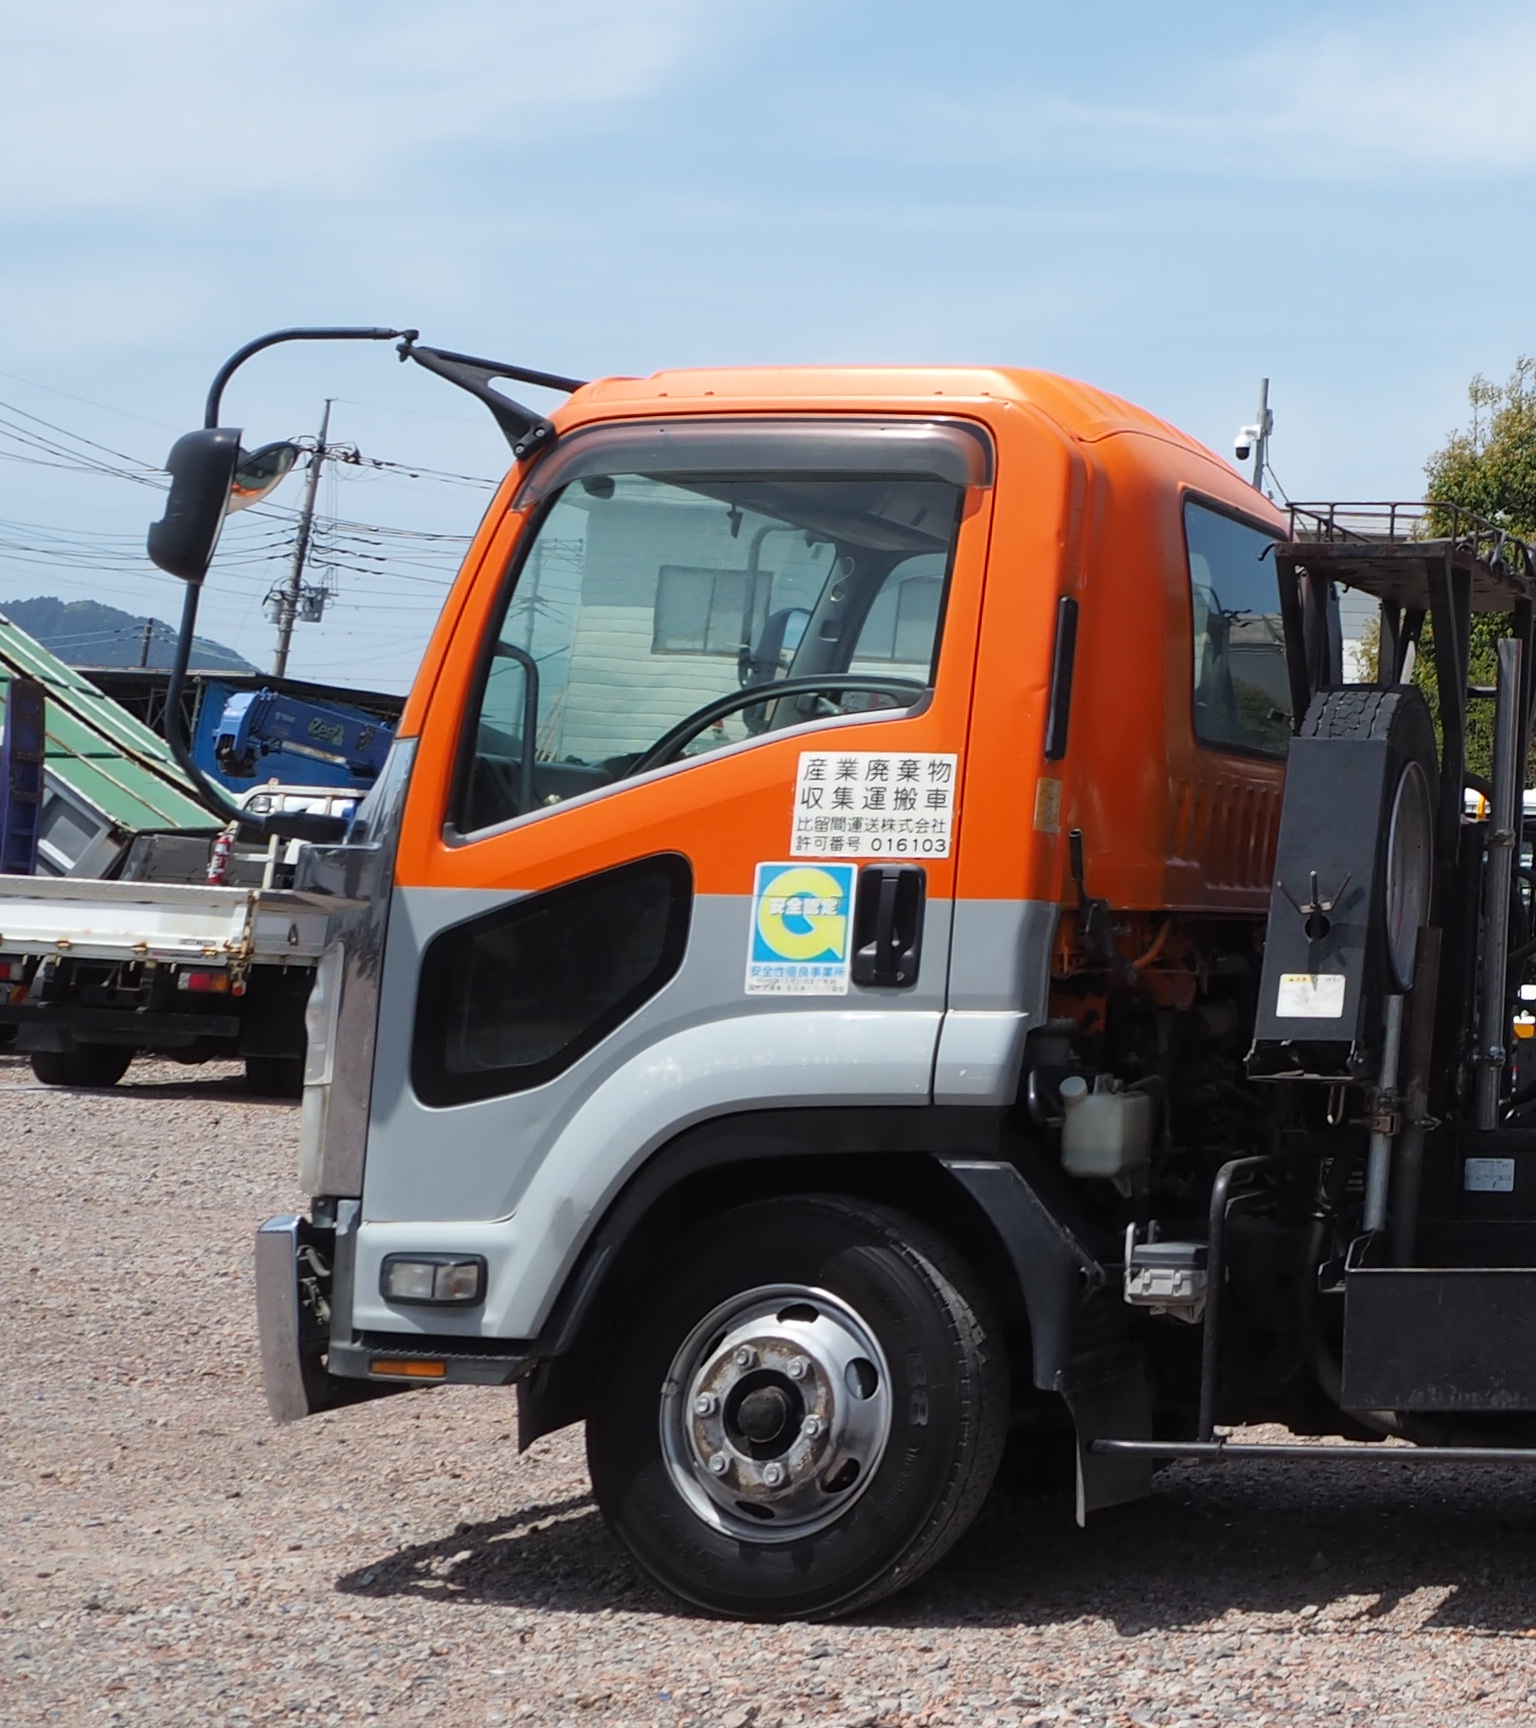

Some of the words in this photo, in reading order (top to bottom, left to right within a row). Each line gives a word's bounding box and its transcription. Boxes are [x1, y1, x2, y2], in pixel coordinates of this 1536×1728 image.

[803, 758, 952, 784] 産業廃棄物
[800, 786, 949, 812] 収集運搬車
[796, 816, 946, 834] 比留間運送株式会社
[796, 835, 861, 852] 許可番号
[871, 837, 946, 853] 016103
